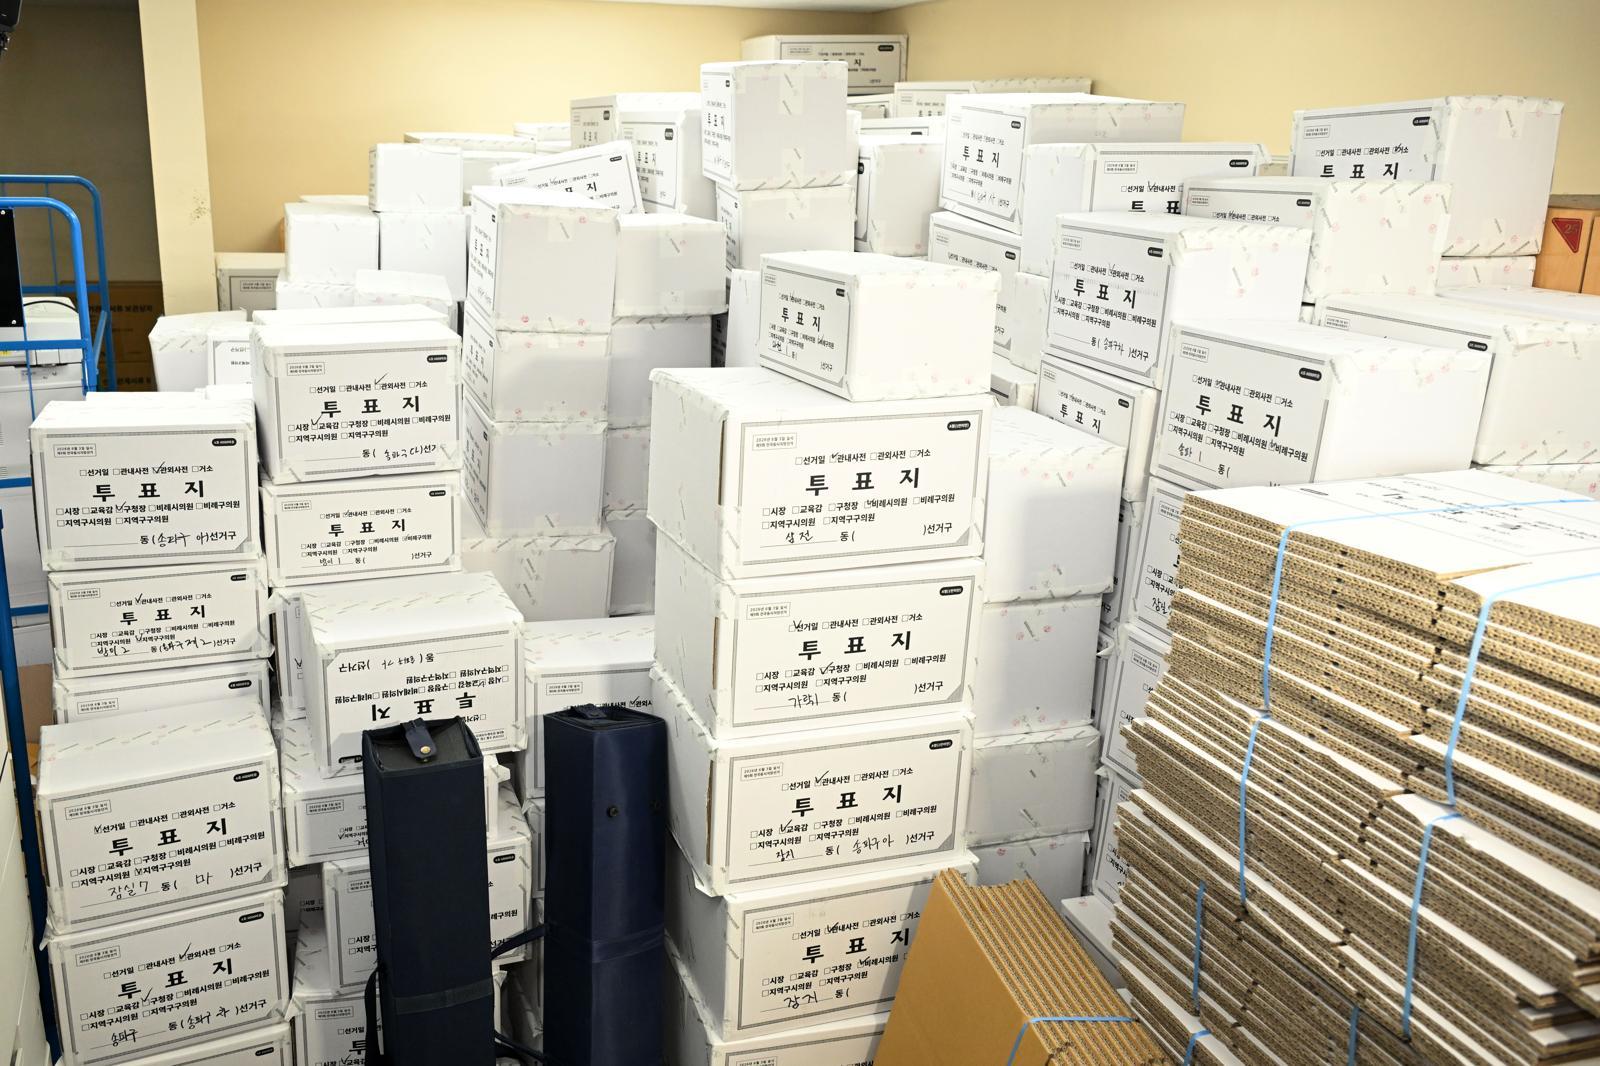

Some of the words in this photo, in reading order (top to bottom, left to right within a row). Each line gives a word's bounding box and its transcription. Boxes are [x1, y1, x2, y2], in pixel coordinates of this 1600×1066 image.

[346, 384, 371, 392] 관내사전
[381, 382, 406, 390] 관외사전
[321, 401, 341, 417] 투
[362, 399, 381, 413] 표
[403, 396, 419, 412] 지
[318, 422, 339, 430] 교육감
[348, 420, 368, 428] 구청장
[377, 417, 410, 426] 비례시의원
[419, 415, 450, 423] 비례구의원
[296, 433, 337, 442] 지역구시의원
[348, 430, 388, 439] 지역구구의원
[803, 456, 825, 465] 선거일
[837, 453, 866, 463] 관내사전
[877, 451, 906, 460] 관외사전
[917, 449, 931, 457] 거소
[161, 466, 188, 474] 관외사전
[93, 484, 115, 502] 투
[138, 483, 160, 498] 표
[185, 481, 203, 497] 지
[806, 475, 828, 496] 투
[852, 472, 874, 490] 표
[899, 468, 919, 488] 지
[65, 507, 80, 515] 시장
[90, 506, 113, 514] 교육감
[124, 505, 146, 513] 구청장
[157, 504, 194, 512] 비례시의원
[203, 501, 240, 509] 비례구의원
[771, 506, 786, 515] 시장
[800, 504, 822, 514] 교육감
[836, 501, 858, 511] 구청장
[872, 498, 907, 509] 비례시의원
[920, 494, 955, 504] 비례구의원
[65, 518, 111, 527] 지역구시의원
[123, 516, 168, 525] 지역구구의원
[329, 524, 344, 537] 투
[360, 522, 375, 533] 표
[392, 519, 405, 531] 지
[770, 518, 815, 529] 지역구시의원
[831, 514, 875, 524] 지역구구의원
[120, 613, 138, 625] 투
[155, 609, 172, 622] 표
[190, 605, 205, 618] 지
[797, 622, 818, 632] 선거일
[830, 619, 858, 629] 관내사전
[870, 615, 898, 625] 관외사전
[909, 613, 923, 622] 거소
[798, 640, 821, 660] 투
[844, 636, 866, 654] 표
[891, 631, 911, 650] 지
[764, 671, 779, 680] 시장
[793, 667, 815, 678] 교육감
[829, 664, 850, 674] 구청장
[863, 659, 899, 670] 비례시의원
[912, 654, 946, 665] 비례구의원
[764, 680, 808, 691] 지역구시의원
[823, 675, 867, 686] 지역구구의원
[789, 780, 811, 790] 선거일
[822, 775, 850, 786] 관내사전
[861, 770, 889, 781] 관외사전
[899, 767, 913, 776] 거소
[792, 798, 814, 817] 투
[836, 792, 858, 809] 표
[882, 785, 902, 803] 지
[102, 822, 126, 833] 선거일
[137, 814, 168, 827] 관내사전
[179, 806, 210, 818] 관외사전
[221, 802, 235, 810] 거소
[109, 838, 133, 856] 투
[157, 829, 181, 846] 표
[206, 818, 227, 836] 지
[79, 866, 95, 875] 시장
[107, 859, 131, 871] 교육감
[143, 852, 166, 863] 구청장
[177, 842, 217, 856] 비례시의원
[227, 832, 265, 846] 비례구의원
[81, 871, 130, 887] 지역구시의원
[143, 859, 191, 874] 지역구구의원
[800, 929, 821, 940] 선거일
[869, 916, 897, 927] 관외사전
[802, 945, 824, 964] 투
[846, 937, 867, 955] 표
[891, 928, 909, 946] 지
[112, 967, 134, 977] 선거일
[145, 957, 175, 970] 관내사전
[186, 948, 216, 960] 관외사전
[226, 942, 241, 951] 거소
[118, 982, 141, 999] 투
[165, 971, 187, 988] 표
[212, 959, 232, 975] 지
[90, 1014, 138, 1029] 지역구시의원
[150, 998, 197, 1015] 지역구구의원
